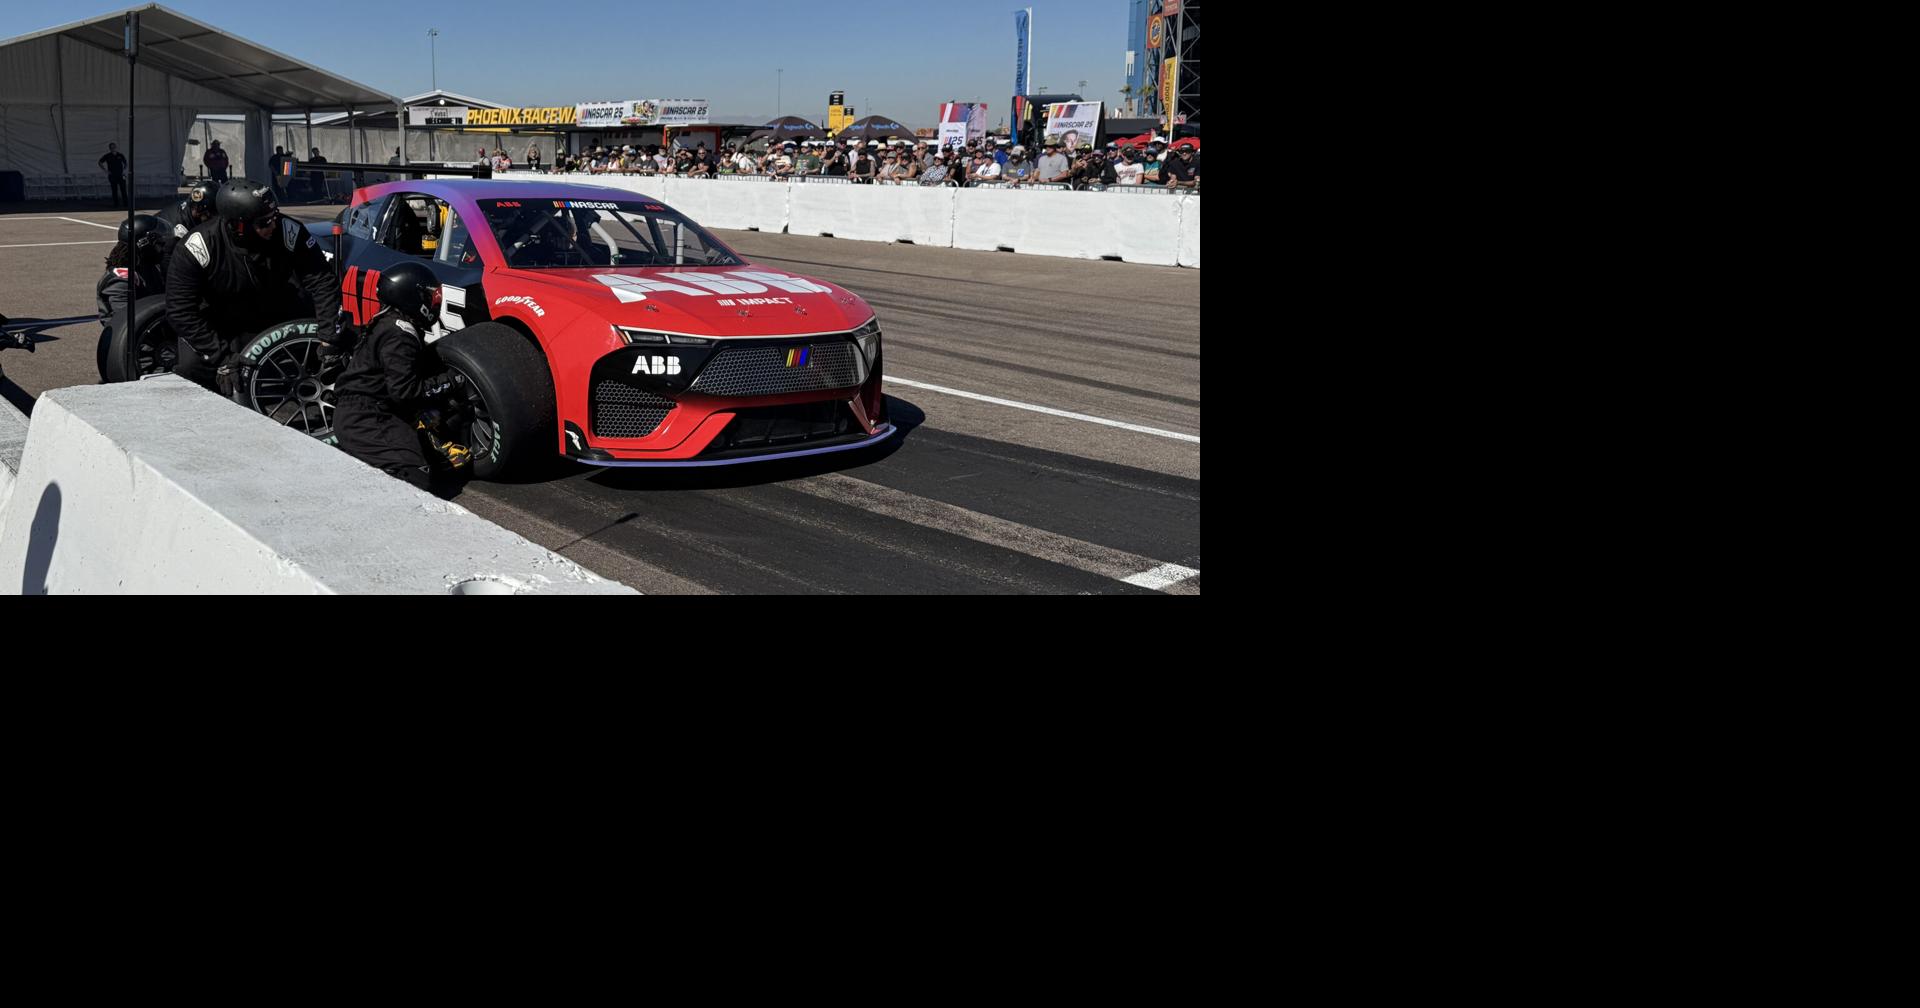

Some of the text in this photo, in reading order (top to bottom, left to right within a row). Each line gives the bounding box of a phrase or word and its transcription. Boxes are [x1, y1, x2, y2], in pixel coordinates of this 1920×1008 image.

[466, 108, 523, 125] PHOENIX
[588, 107, 624, 119] NASCAR 25
[670, 106, 707, 115] NASCAR 25
[1059, 121, 1085, 129] NASCAR
[568, 201, 619, 211] NASCAR
[591, 271, 832, 304] ABB
[495, 295, 545, 317] GOODYEAR
[738, 296, 793, 305] IMPACT
[632, 354, 681, 376] ABB
[491, 420, 501, 463] EAGLE
